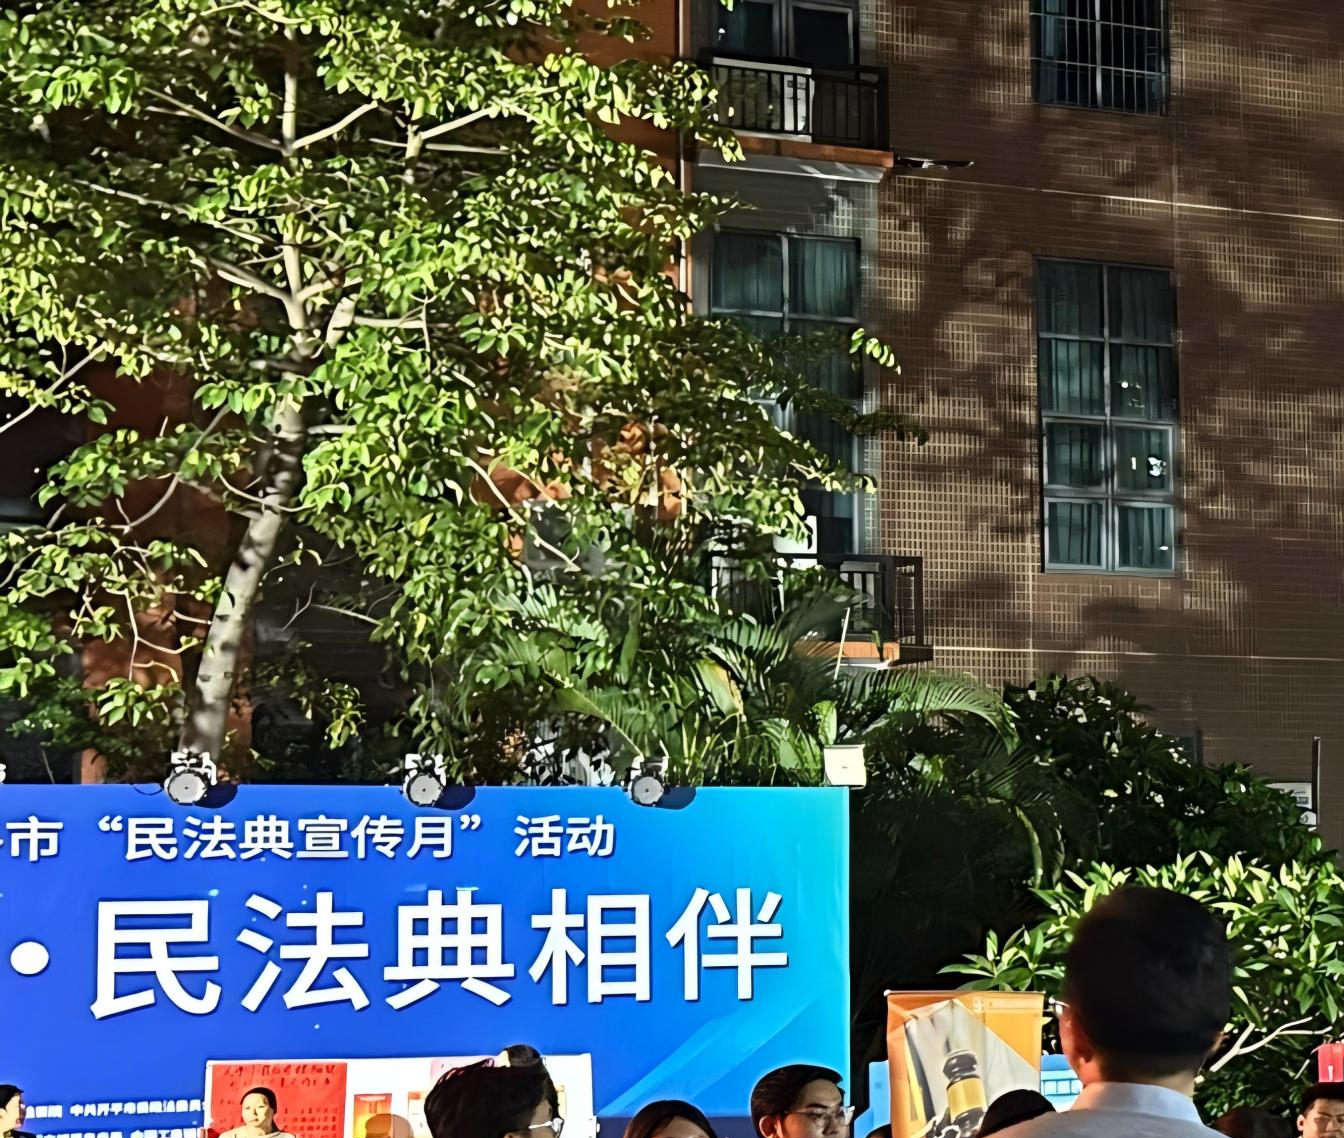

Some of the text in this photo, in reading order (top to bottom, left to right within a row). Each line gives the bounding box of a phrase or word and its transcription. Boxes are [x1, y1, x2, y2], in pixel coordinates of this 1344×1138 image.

[0, 813, 616, 862] 市 “民法典宣传月” 活动
